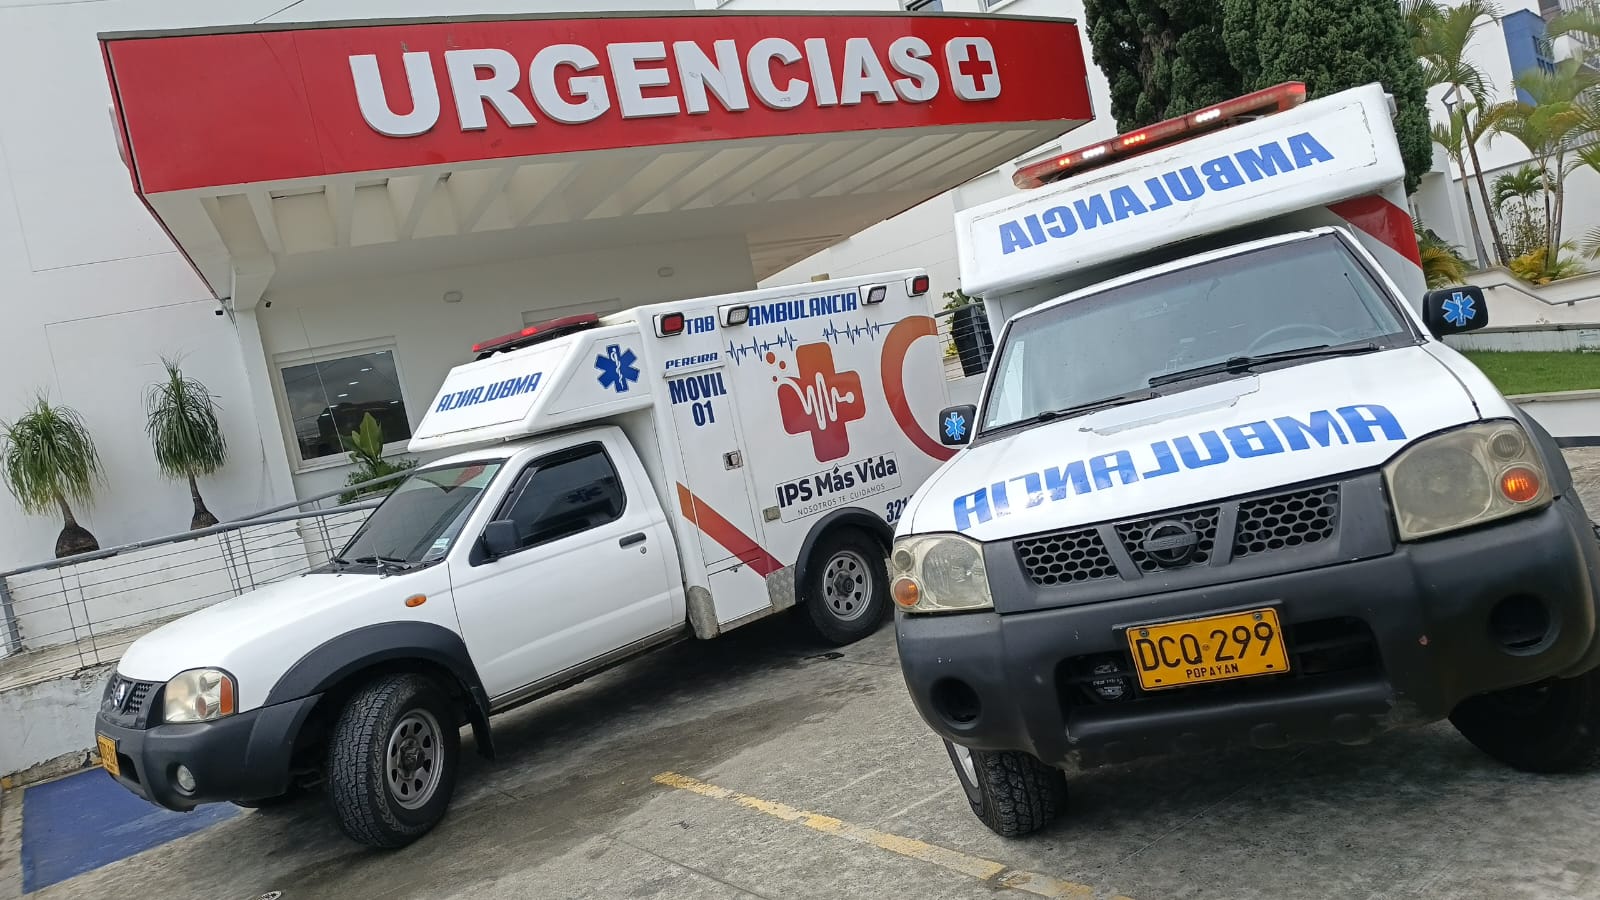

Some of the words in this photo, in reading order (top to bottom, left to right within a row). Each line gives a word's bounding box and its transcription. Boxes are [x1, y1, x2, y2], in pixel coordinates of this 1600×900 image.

[348, 36, 940, 138] URGENCIAS
[684, 315, 715, 335] TAB
[748, 292, 857, 327] AMBULANCIA
[665, 352, 718, 370] PEREIRA
[668, 372, 727, 405] MOVIL
[692, 400, 715, 427] 01
[777, 478, 813, 508] IPS
[814, 466, 855, 497] Más
[855, 456, 898, 483] Vida
[797, 499, 837, 516] NOSOTROS
[839, 495, 846, 503] TE
[850, 483, 886, 500] CUIDAMOS
[886, 494, 914, 523] 321
[1135, 633, 1203, 672] DCQ
[1210, 622, 1274, 662] 299
[1186, 663, 1239, 679] POPAYAN
